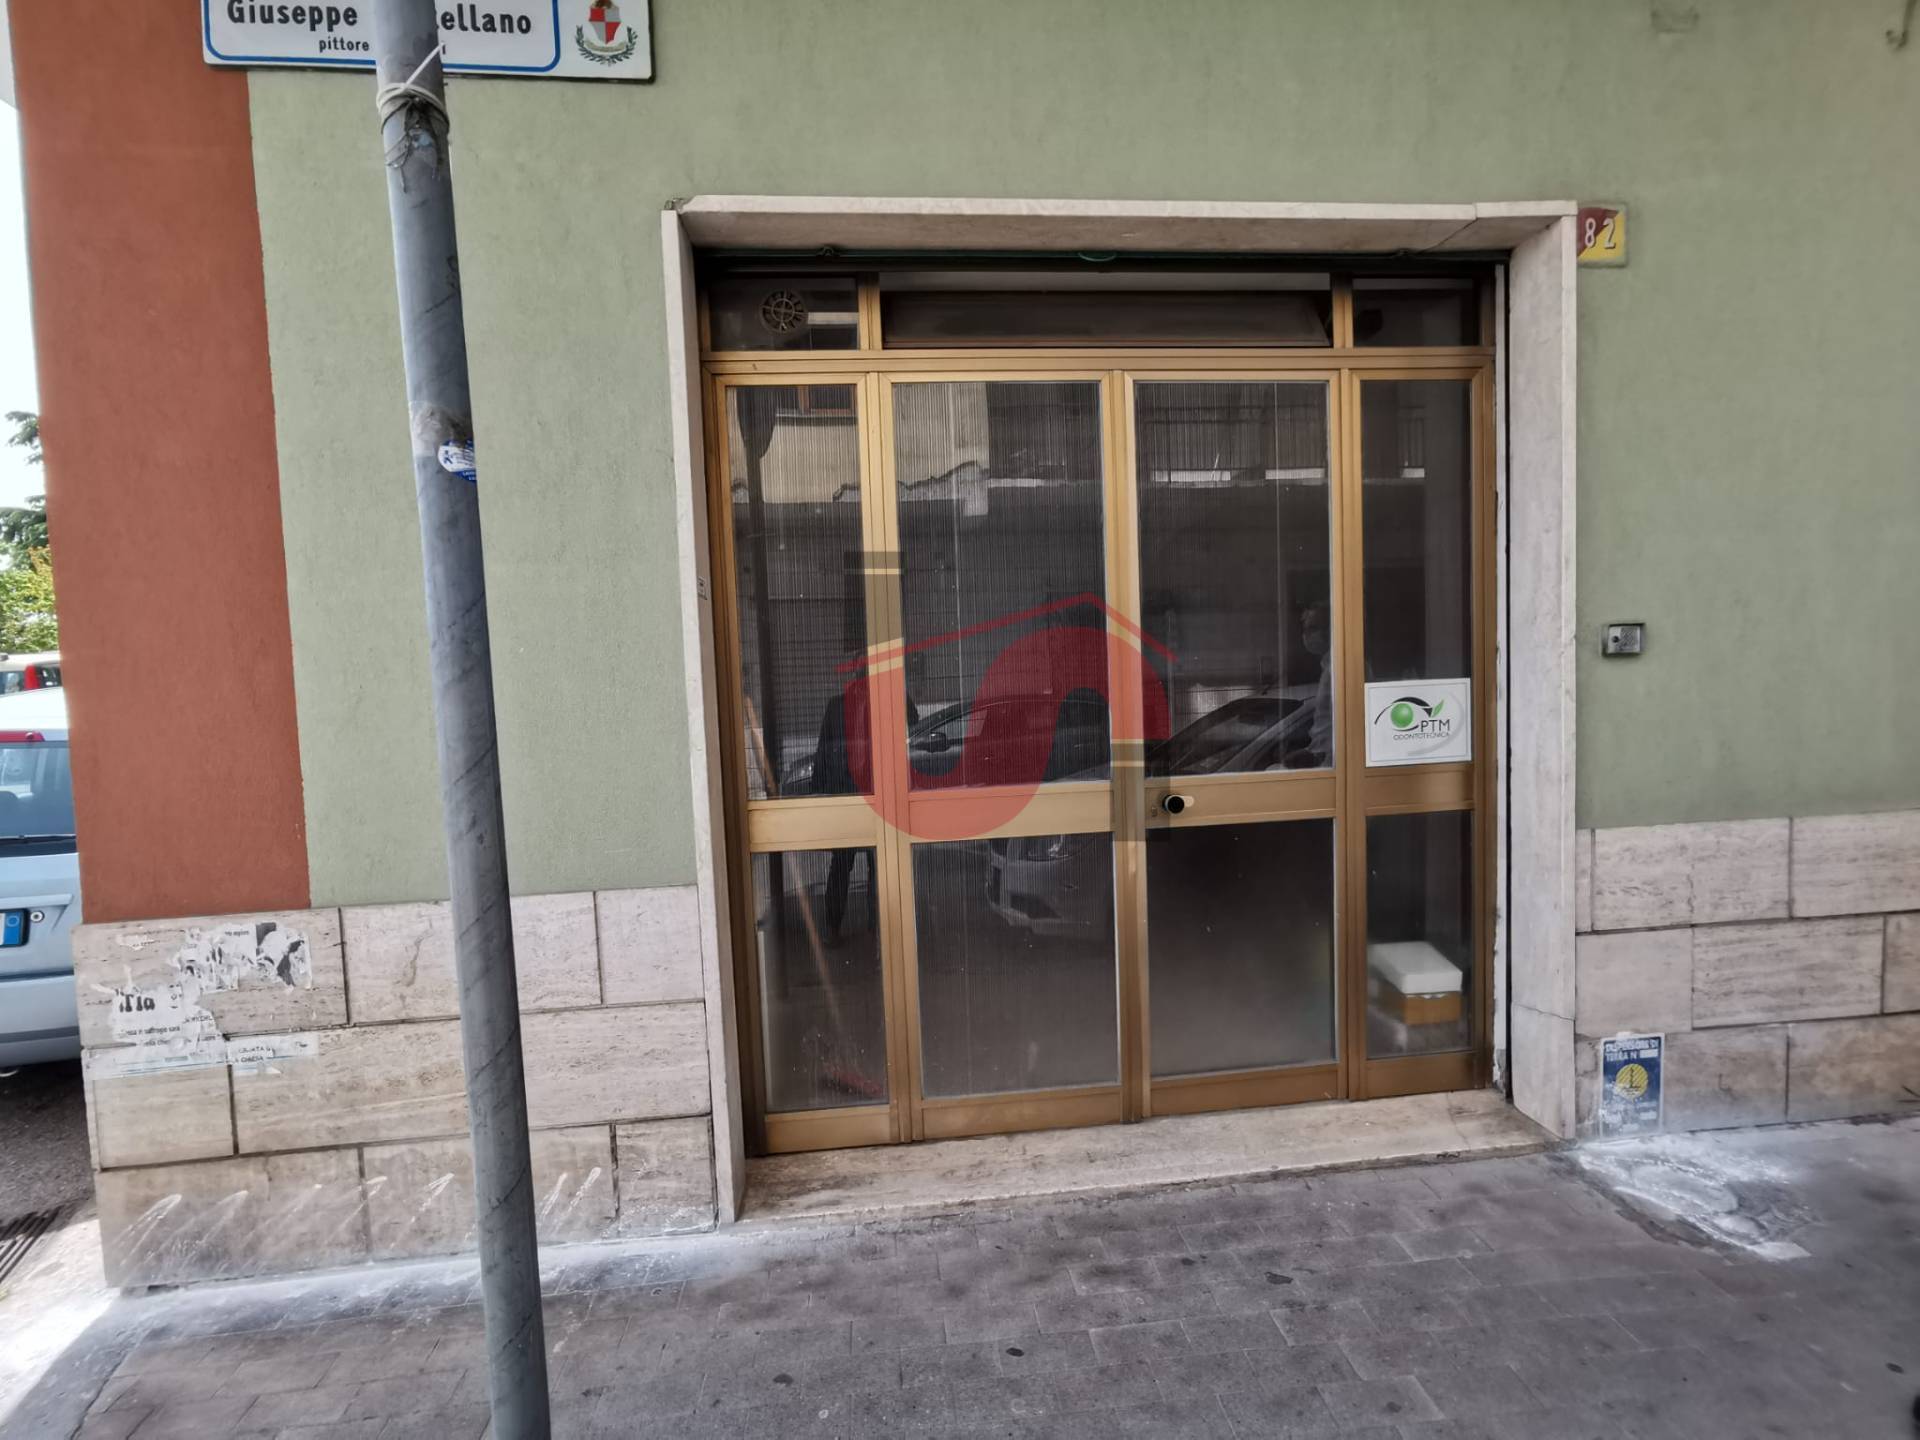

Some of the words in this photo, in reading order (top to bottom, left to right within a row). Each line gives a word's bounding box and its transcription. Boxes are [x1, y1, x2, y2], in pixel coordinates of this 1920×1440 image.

[227, 0, 358, 32] Giuseppe
[438, 3, 531, 34] ellano
[319, 36, 370, 53] pittore
[1585, 217, 1617, 250] 82
